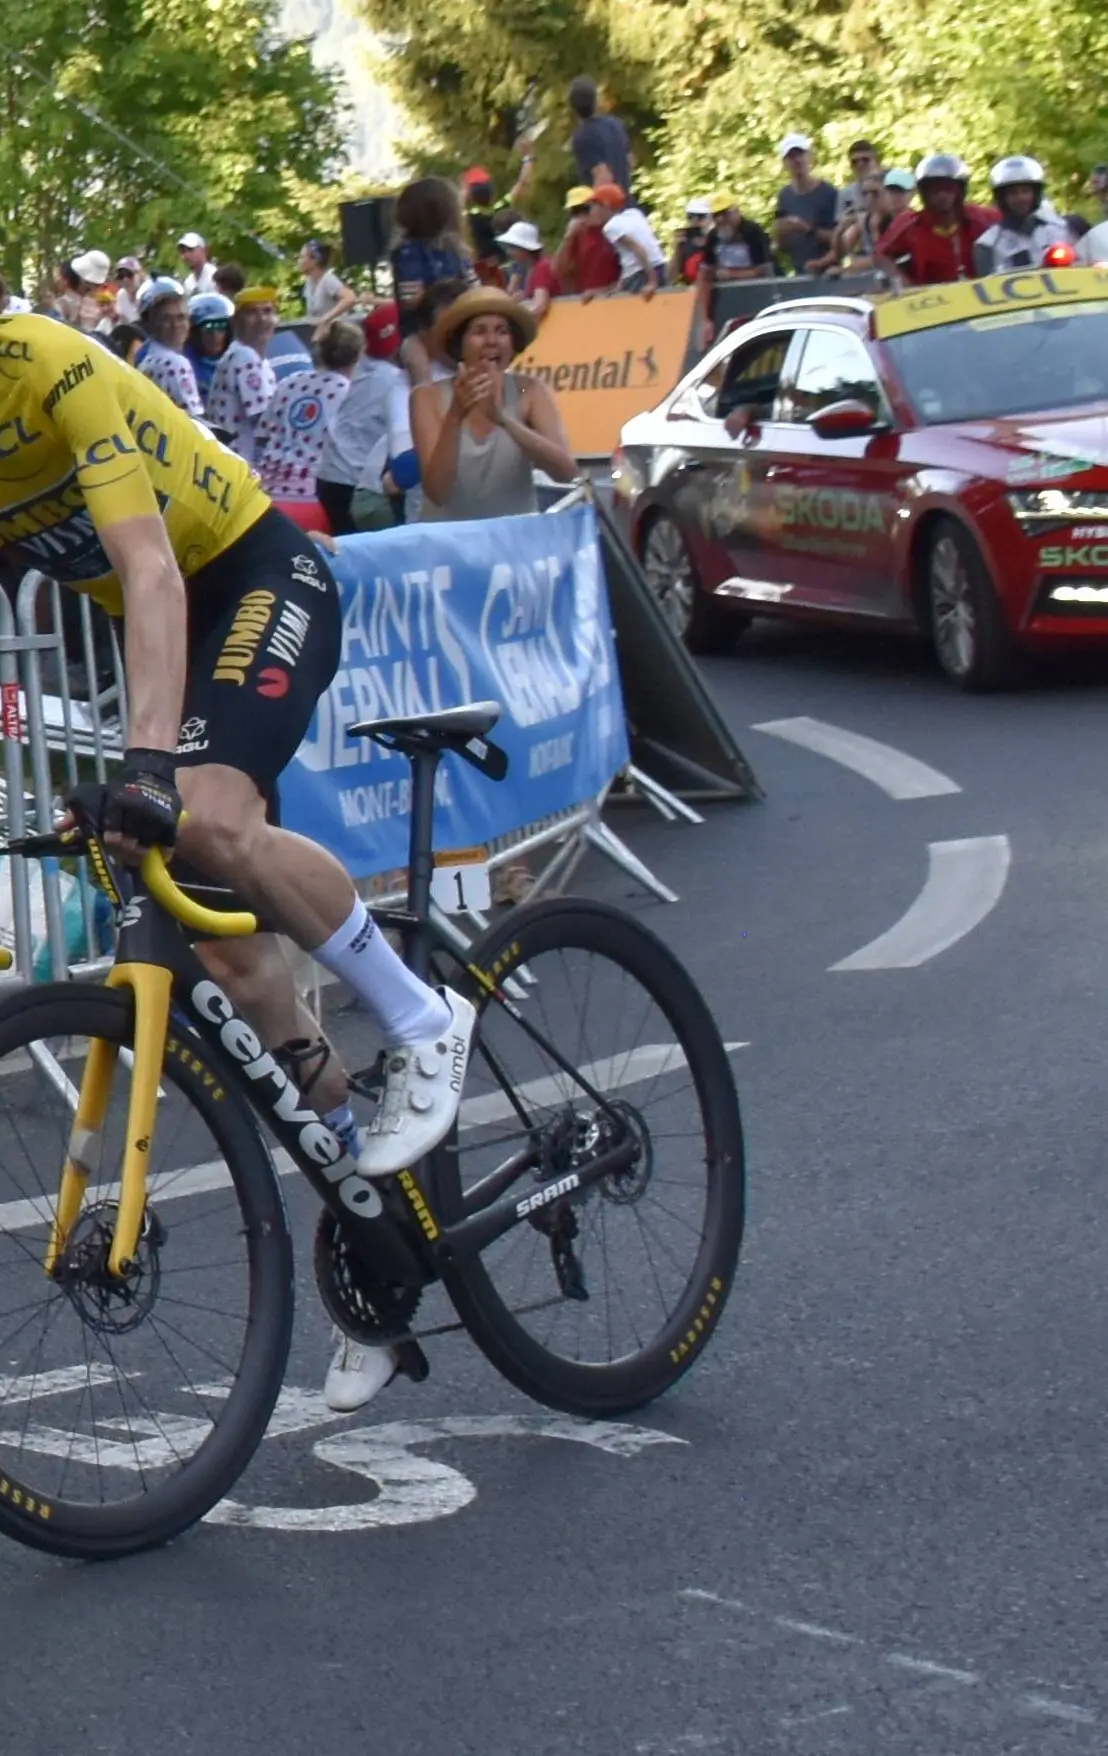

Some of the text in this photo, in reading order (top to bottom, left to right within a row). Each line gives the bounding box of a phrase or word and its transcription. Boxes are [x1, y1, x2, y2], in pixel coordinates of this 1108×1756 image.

[972, 273, 1079, 306] LCL
[193, 452, 233, 514] LCL
[212, 589, 277, 687] JUMBO
[266, 599, 311, 667] VISMA
[337, 567, 430, 663] AINT
[453, 871, 469, 910] 1
[449, 1034, 466, 1093] nimbl
[516, 1174, 579, 1218] SRAM
